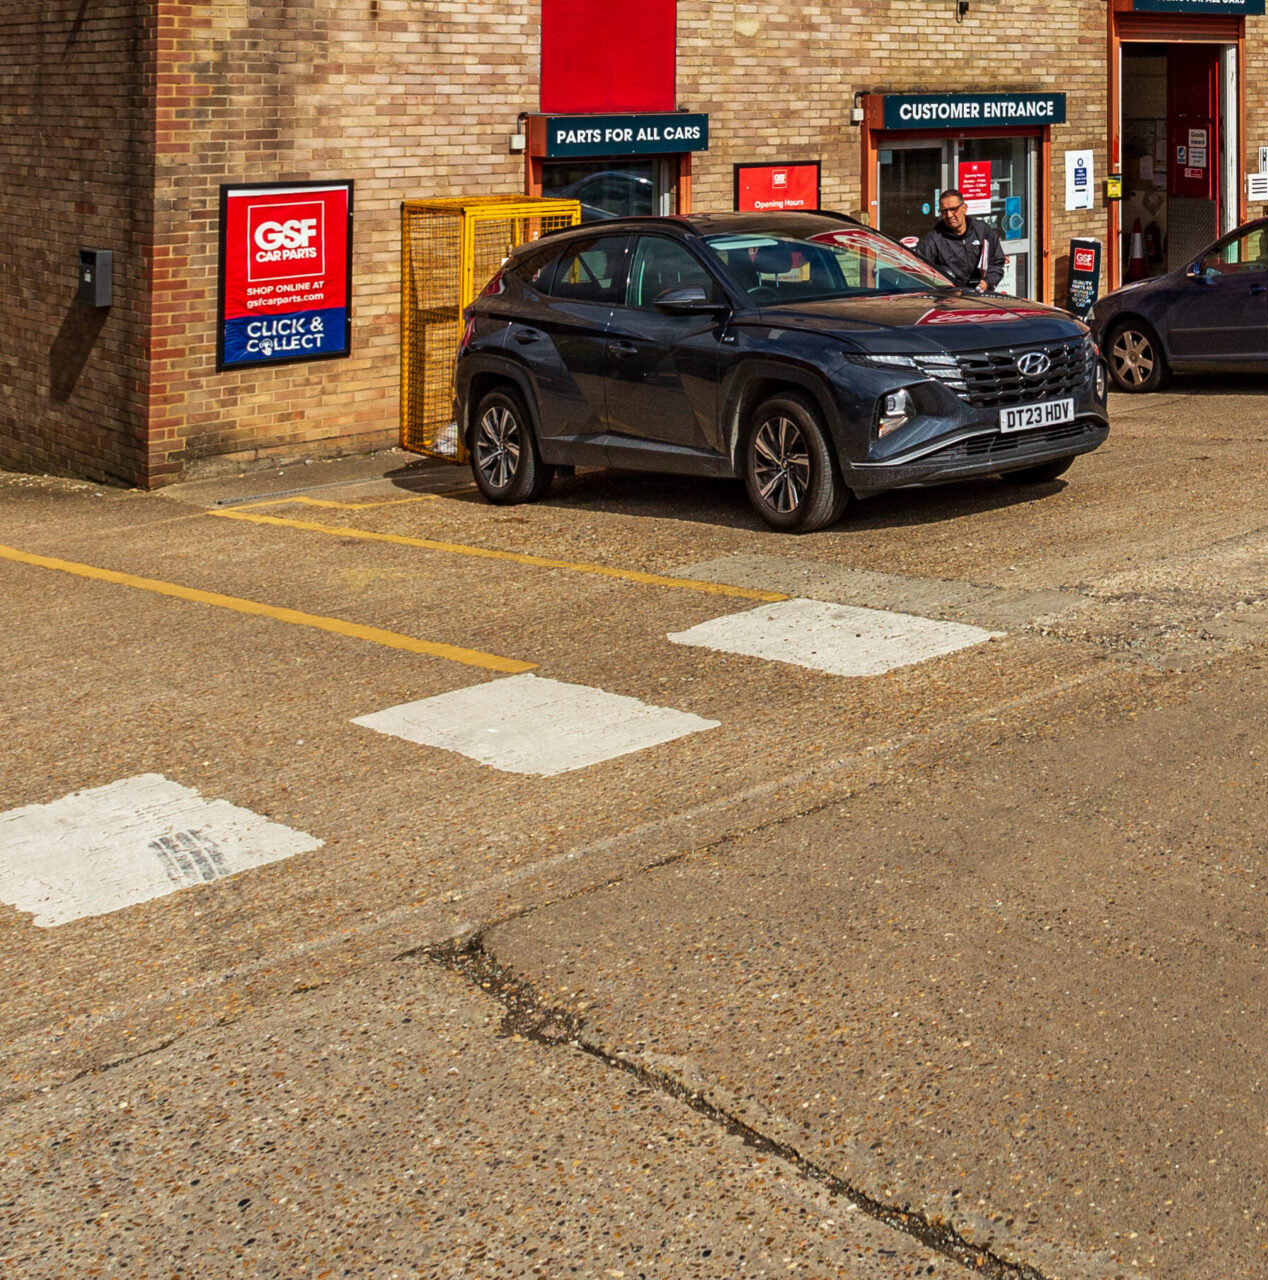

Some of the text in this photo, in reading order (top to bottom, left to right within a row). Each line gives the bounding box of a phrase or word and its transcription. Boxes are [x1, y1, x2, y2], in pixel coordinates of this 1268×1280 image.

[900, 101, 1054, 120] CUSTOMER ENTRANCE
[556, 126, 701, 144] PARTS FOR ALL CARS
[754, 200, 783, 209] Opening
[254, 218, 317, 251] GSF
[255, 247, 317, 263] CAR PARTS
[1076, 253, 1092, 263] GSF
[246, 281, 324, 296] SHOP ONLINE AT
[246, 292, 324, 309] gsfcarparts.com
[247, 316, 324, 338] CLICK &
[1006, 401, 1069, 429] DT23 HDV
